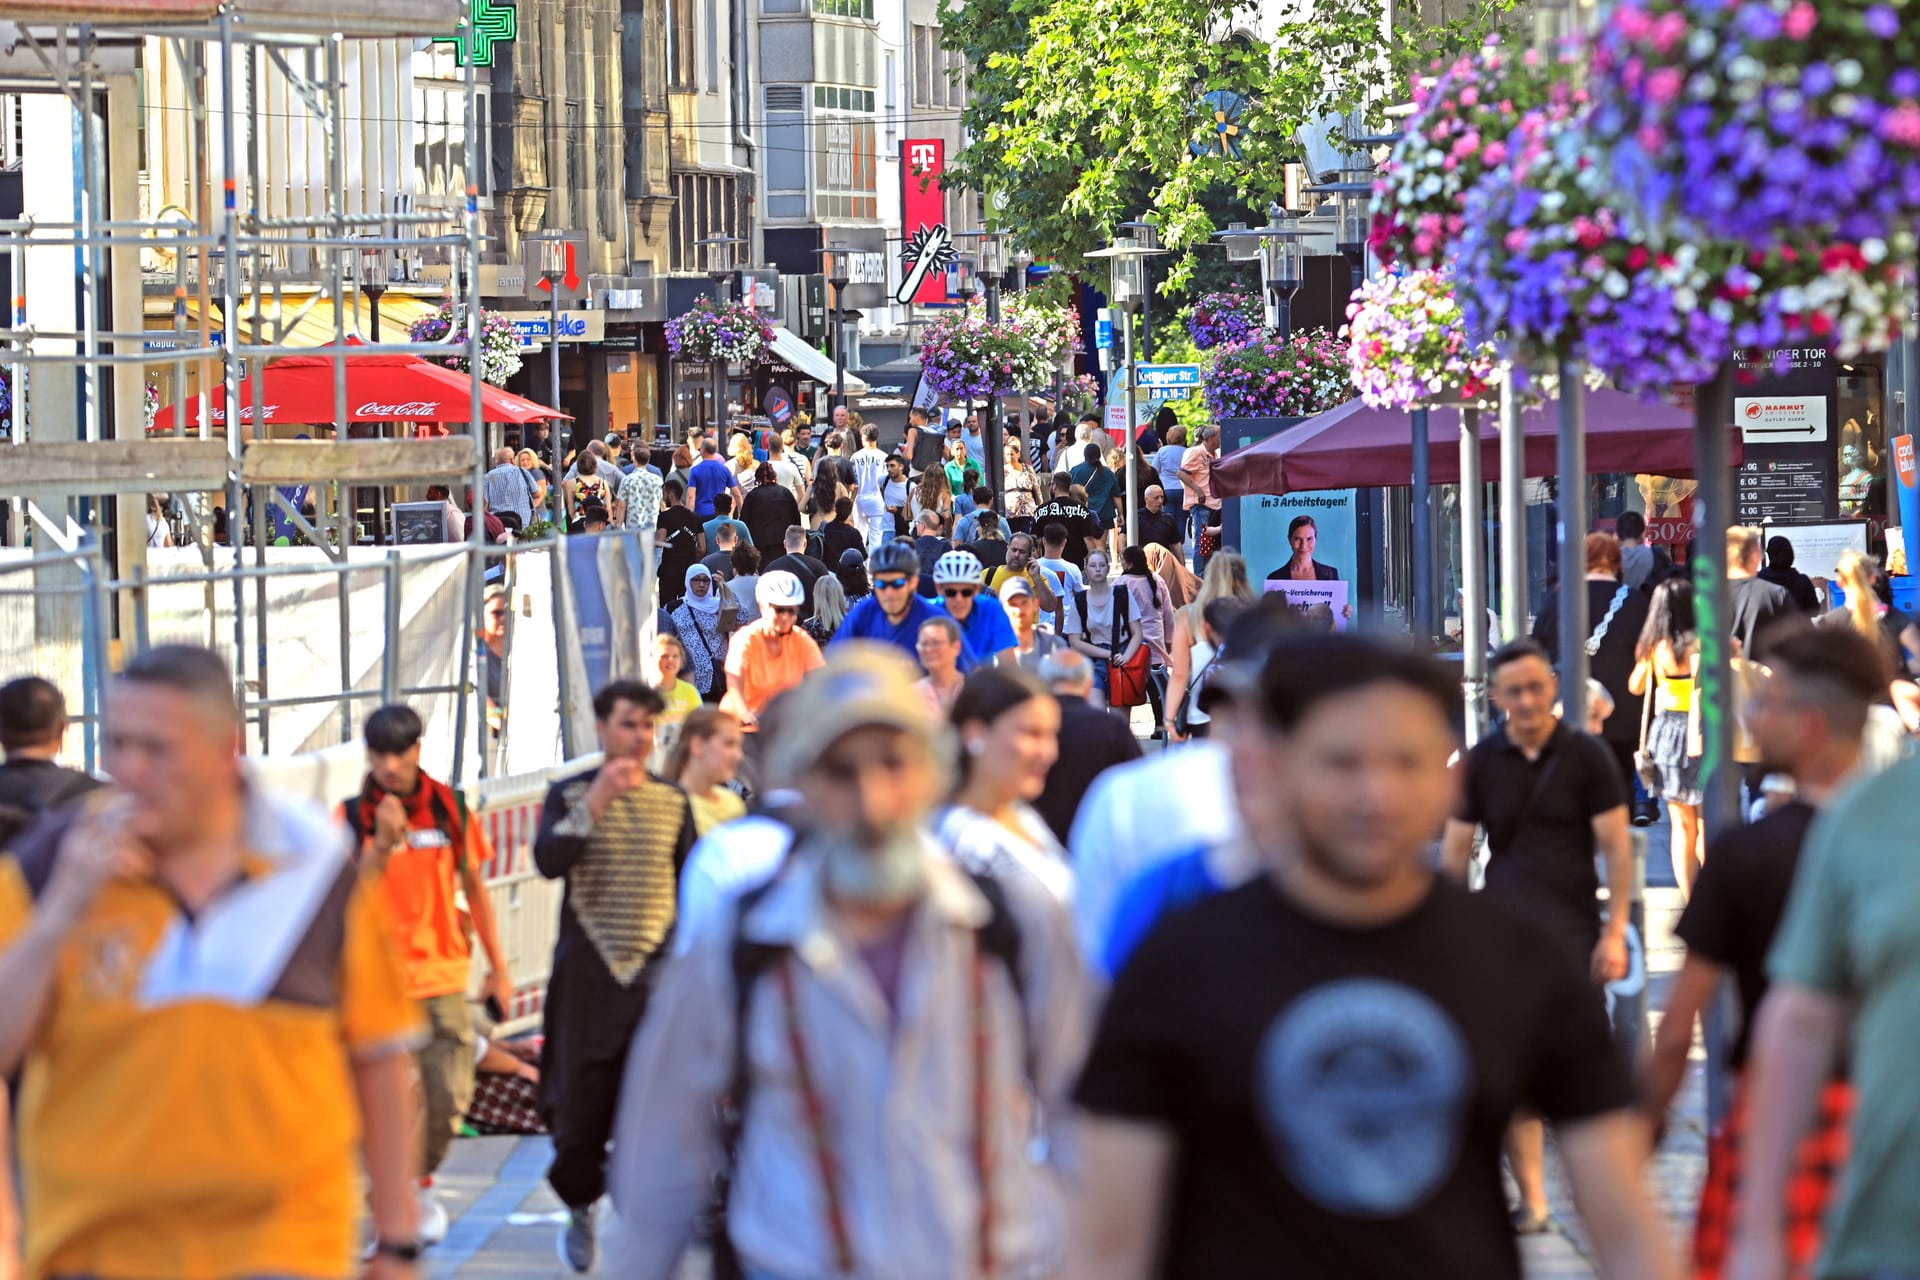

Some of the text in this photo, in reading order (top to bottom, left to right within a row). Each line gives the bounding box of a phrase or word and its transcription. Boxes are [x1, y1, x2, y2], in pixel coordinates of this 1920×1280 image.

[532, 323, 546, 333] Str.
[1803, 348, 1826, 359] TOR
[1179, 370, 1194, 381] Str.
[355, 401, 441, 416] Coca-Cola
[1898, 444, 1913, 457] cool
[1747, 463, 1757, 471] OG
[1900, 457, 1915, 472] blue
[1747, 478, 1757, 486] OG
[1261, 497, 1348, 508] in 3 Arbeitstagen!
[1748, 507, 1758, 515] OG
[1647, 522, 1697, 541] 50%
